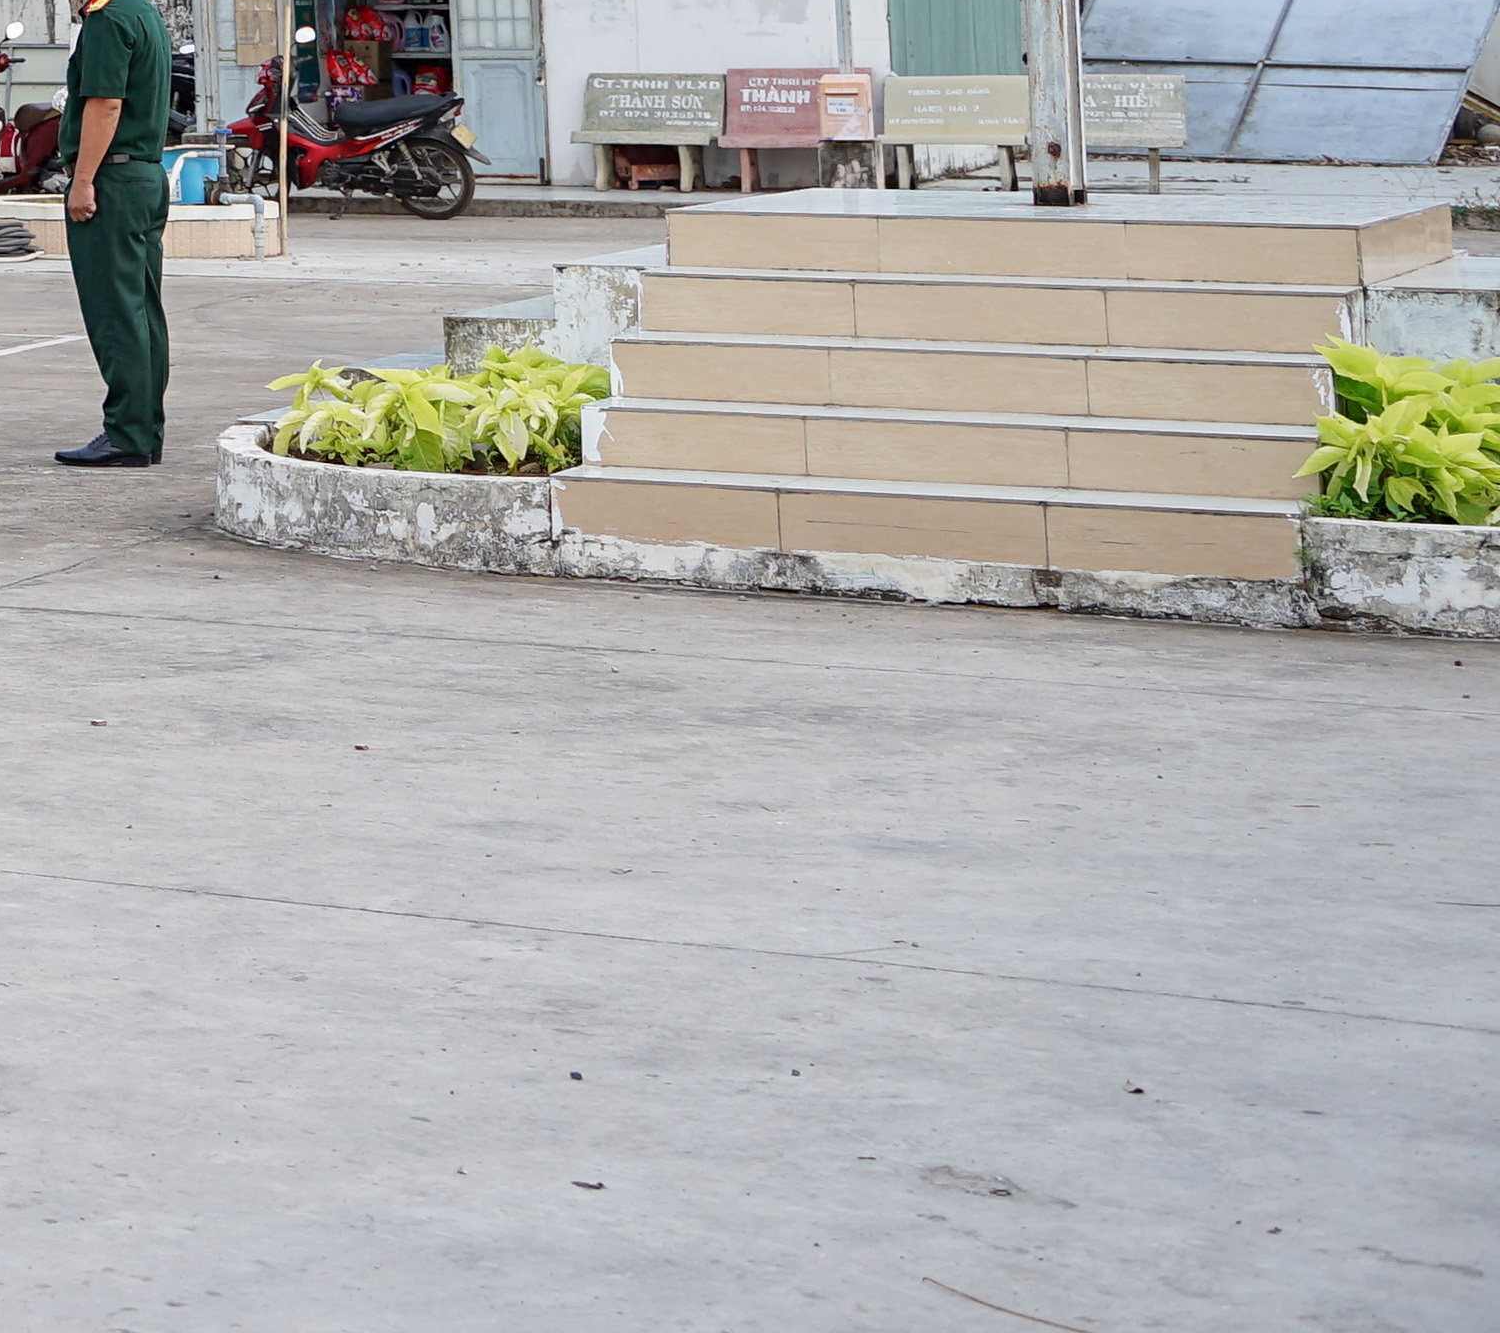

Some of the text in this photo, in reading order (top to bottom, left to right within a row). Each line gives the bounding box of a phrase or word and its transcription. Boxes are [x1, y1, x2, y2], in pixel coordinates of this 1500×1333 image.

[674, 80, 721, 90] VLXD
[608, 92, 705, 110] THÀNH SƠN
[740, 85, 811, 105] THÀNH
[972, 104, 981, 113] 2
